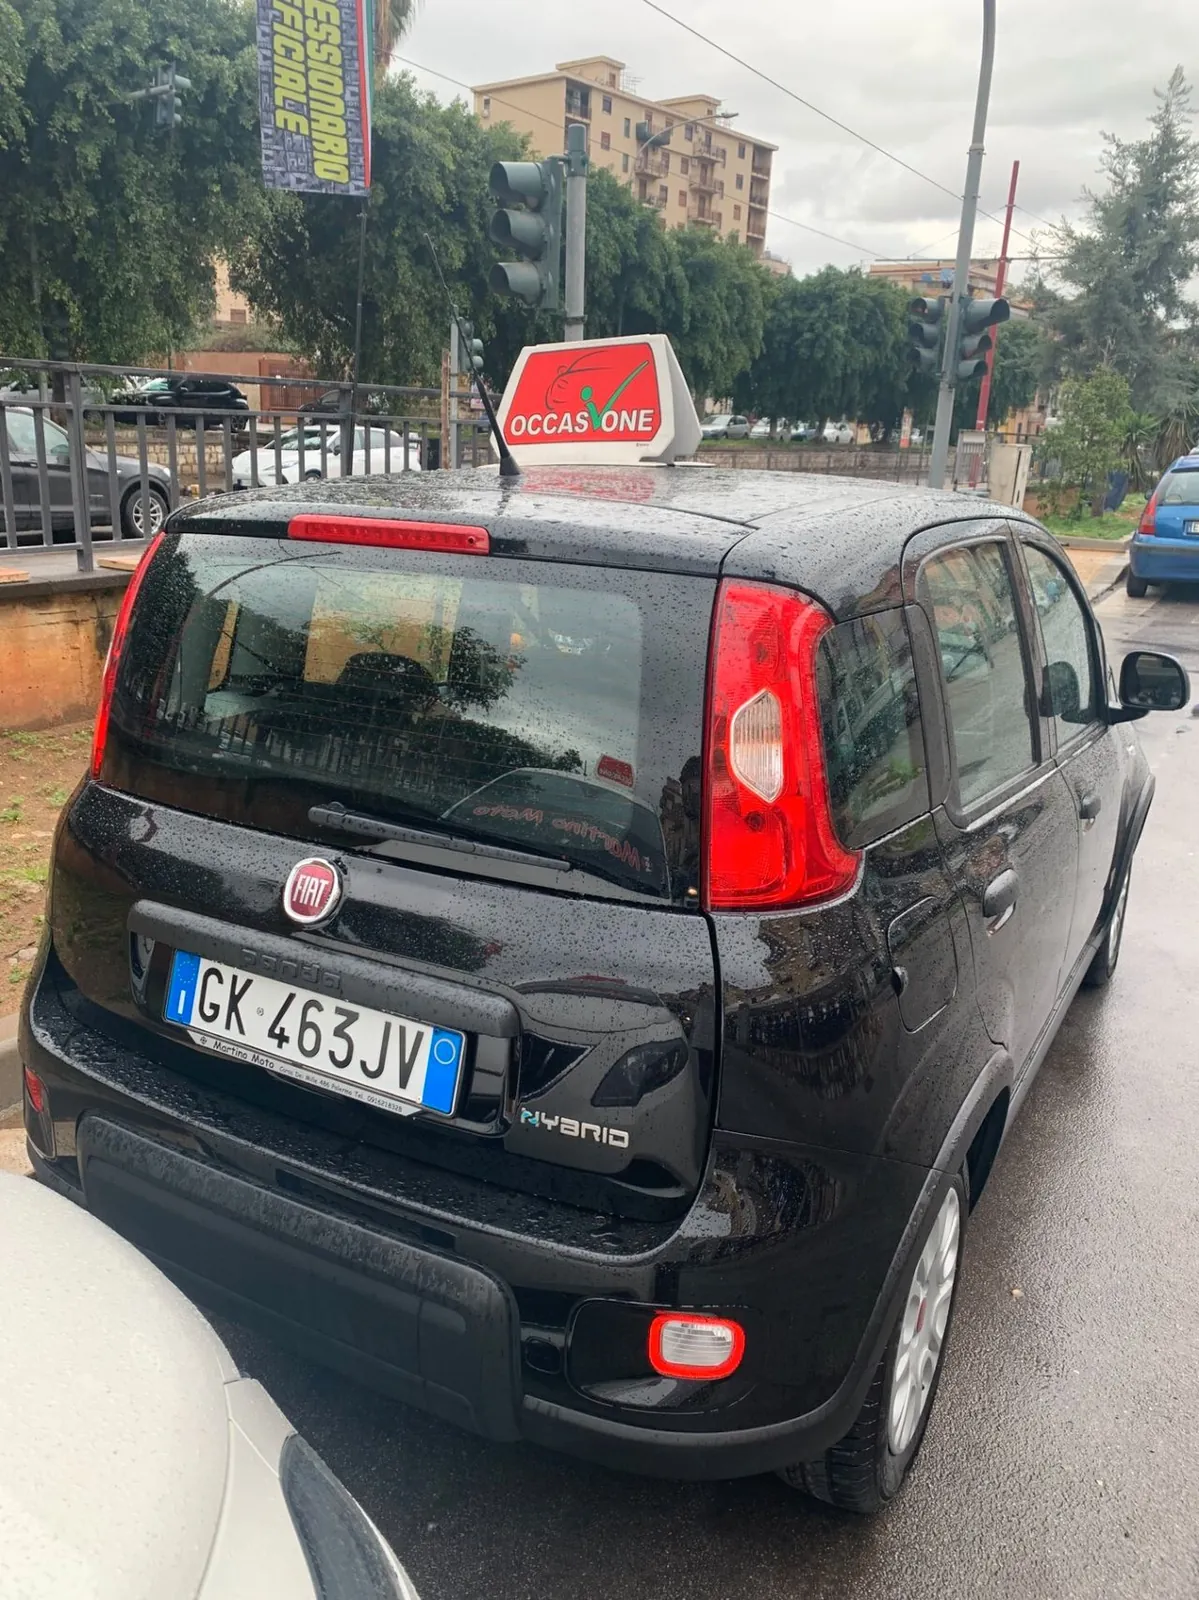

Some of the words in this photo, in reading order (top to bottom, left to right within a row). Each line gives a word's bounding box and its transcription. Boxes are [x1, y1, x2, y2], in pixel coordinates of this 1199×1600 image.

[304, 0, 350, 184] ESSIONARIO
[292, 873, 329, 908] FIAT
[198, 967, 253, 1036] GK
[213, 1040, 248, 1060] Martino
[251, 1054, 275, 1069] Moto
